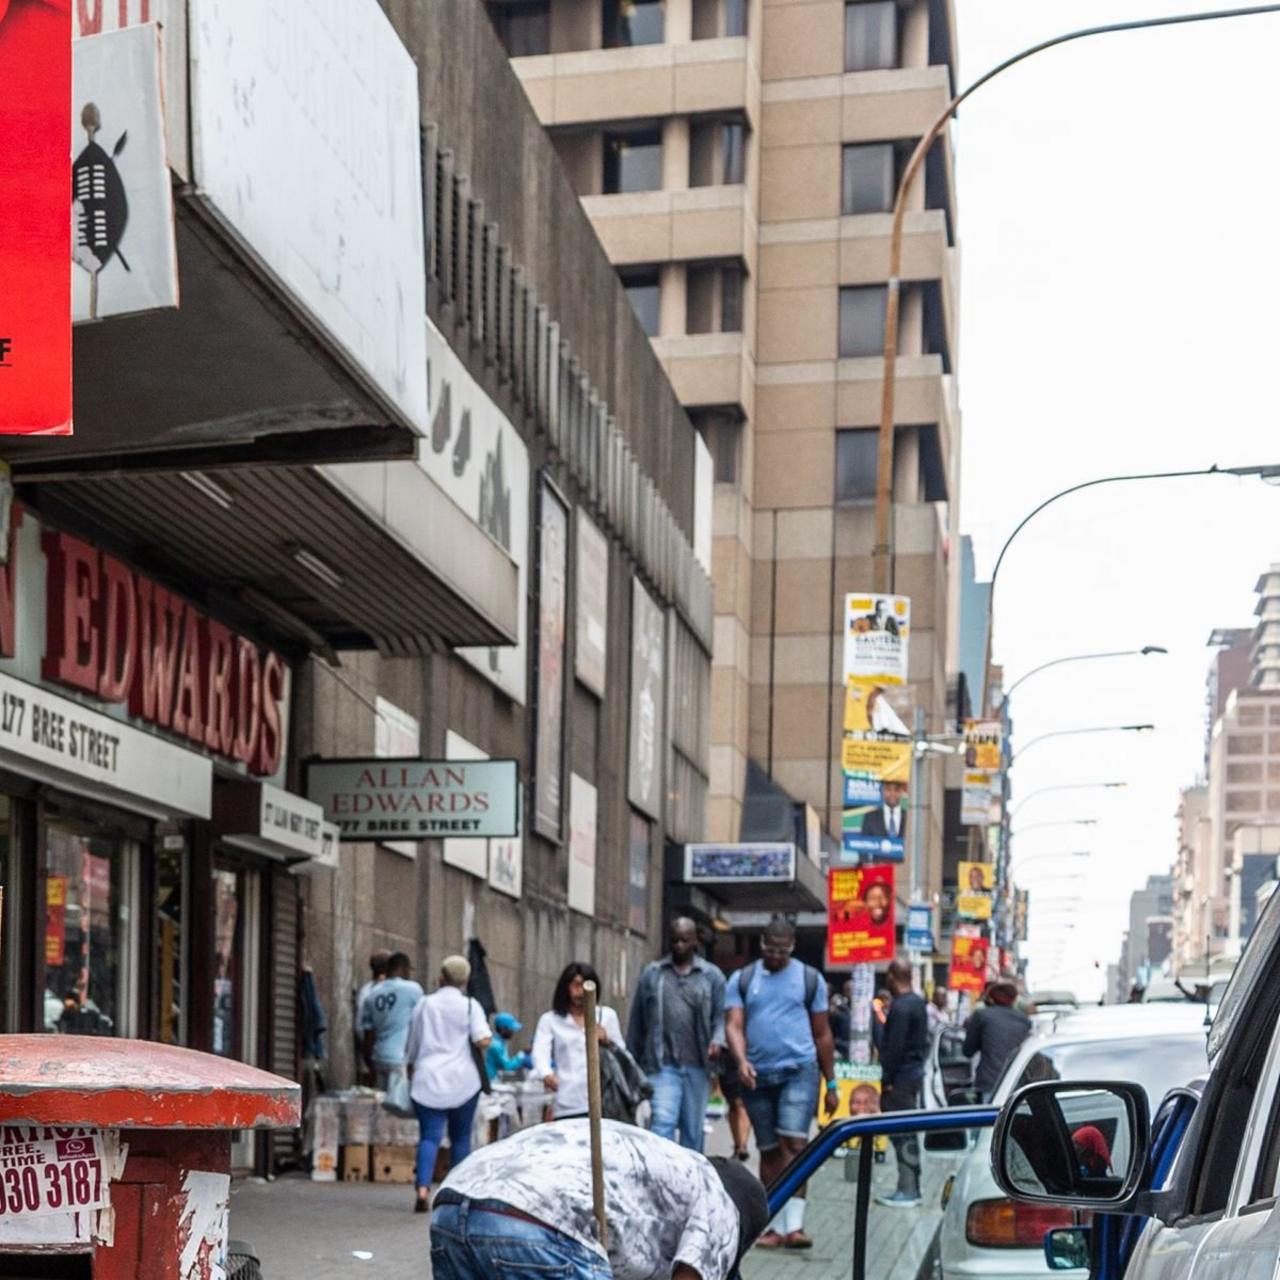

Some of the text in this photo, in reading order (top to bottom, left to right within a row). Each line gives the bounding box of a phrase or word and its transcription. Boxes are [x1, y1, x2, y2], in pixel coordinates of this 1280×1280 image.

[43, 530, 285, 777] EDWARDS
[2, 692, 121, 773] 177 BREE STREET
[356, 767, 466, 789] ALLAN
[332, 792, 490, 813] EDWARDS
[339, 818, 482, 832] 77 BREE STREET
[375, 992, 397, 1012] 09
[0, 1153, 47, 1168] TIME
[44, 1159, 102, 1209] 3187
